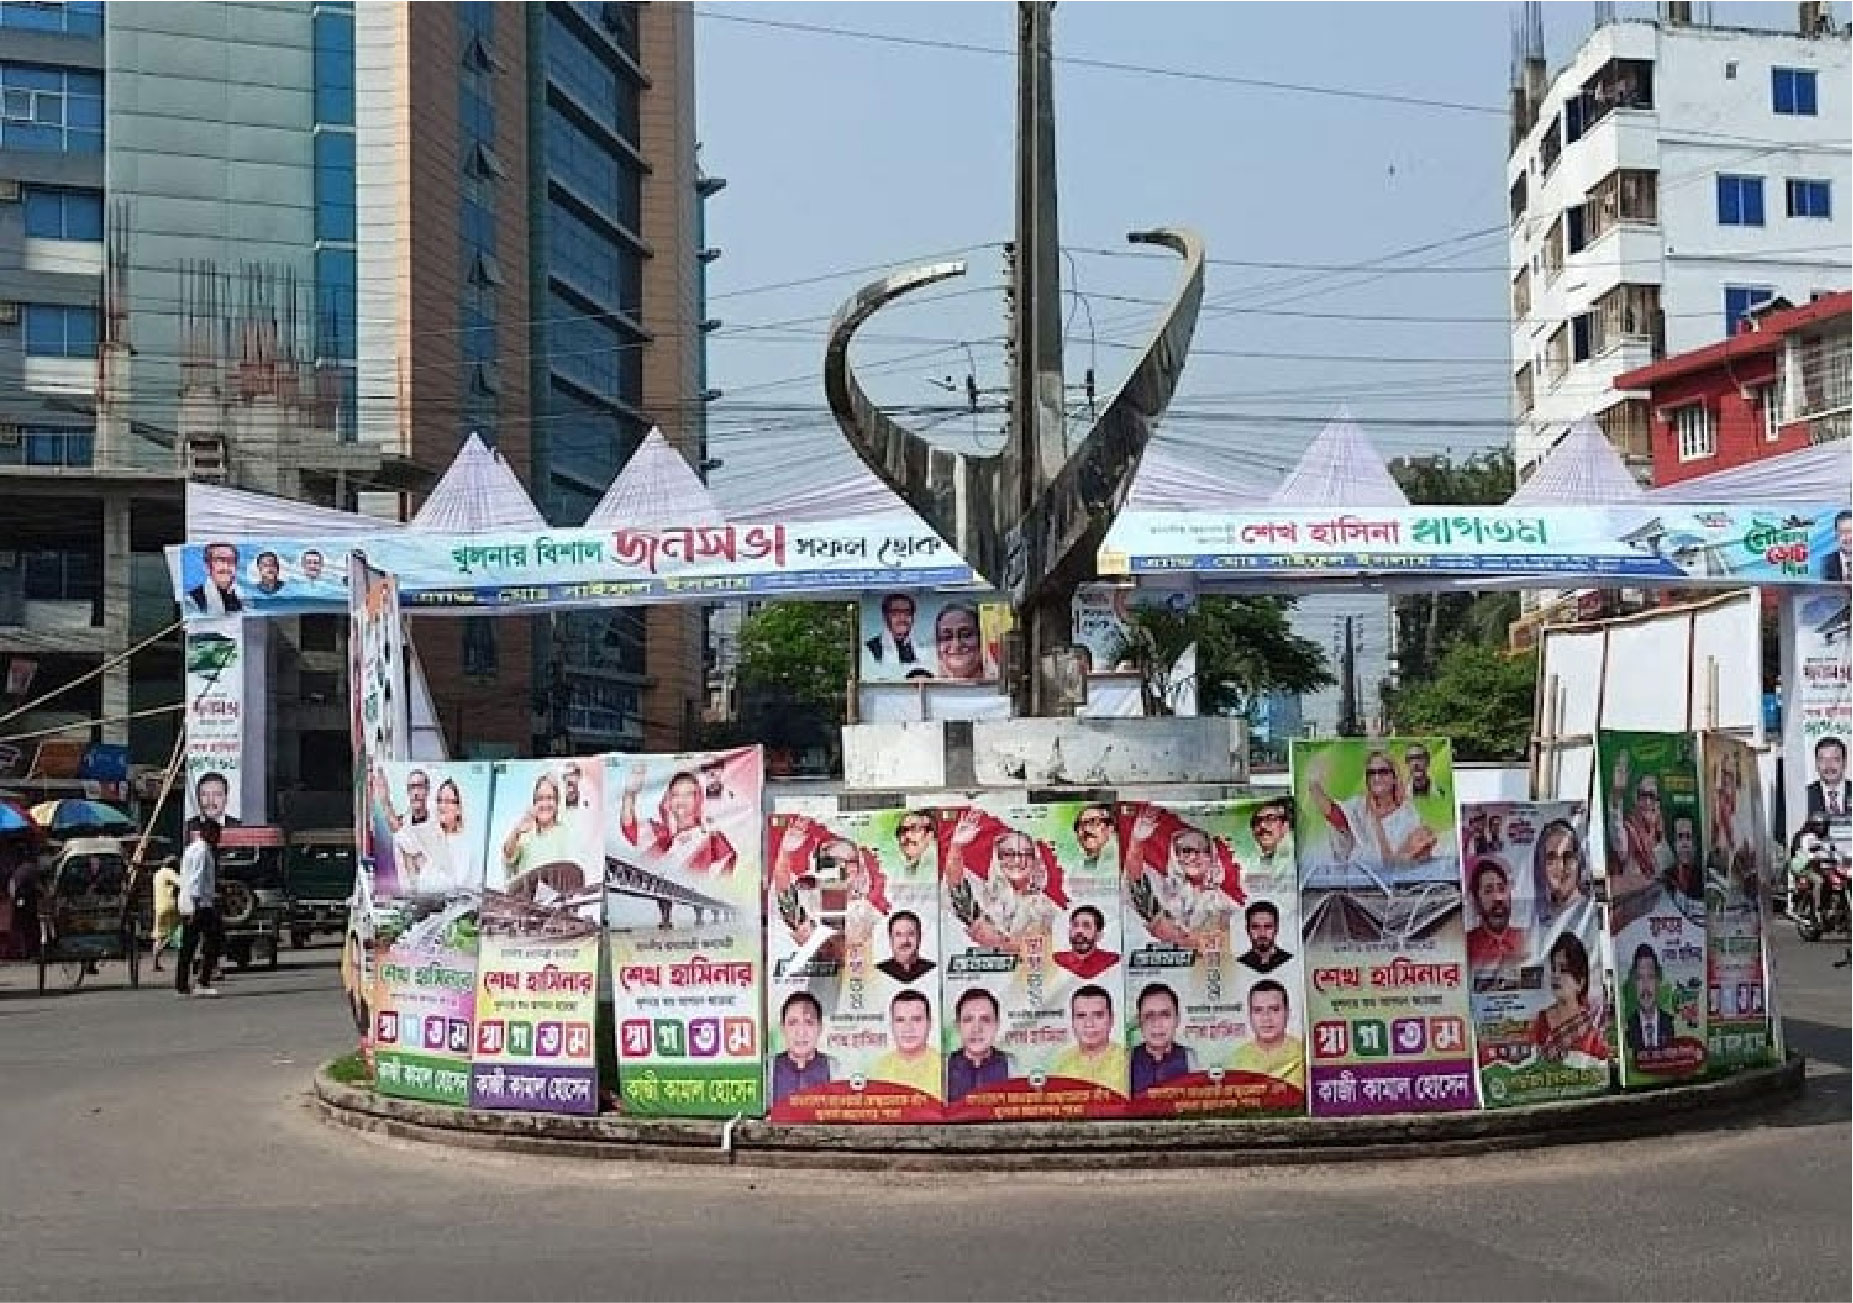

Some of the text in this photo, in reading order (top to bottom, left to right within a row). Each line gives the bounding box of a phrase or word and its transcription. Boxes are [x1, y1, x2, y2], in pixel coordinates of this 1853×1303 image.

[1240, 520, 1297, 546] শেখ
[1306, 514, 1401, 548] হাসিনা
[451, 524, 943, 574] খুলনার বিশাল জনসভা সফল হোক
[483, 963, 594, 998] শেখ হাসিনার
[620, 966, 661, 990] শেখ
[668, 954, 753, 988] হাসিনার
[1313, 956, 1462, 992] শেখ হাসিনার
[1316, 1069, 1357, 1103] কাজী
[1361, 1076, 1411, 1102] কামাল
[1415, 1073, 1468, 1101] হোসেন
